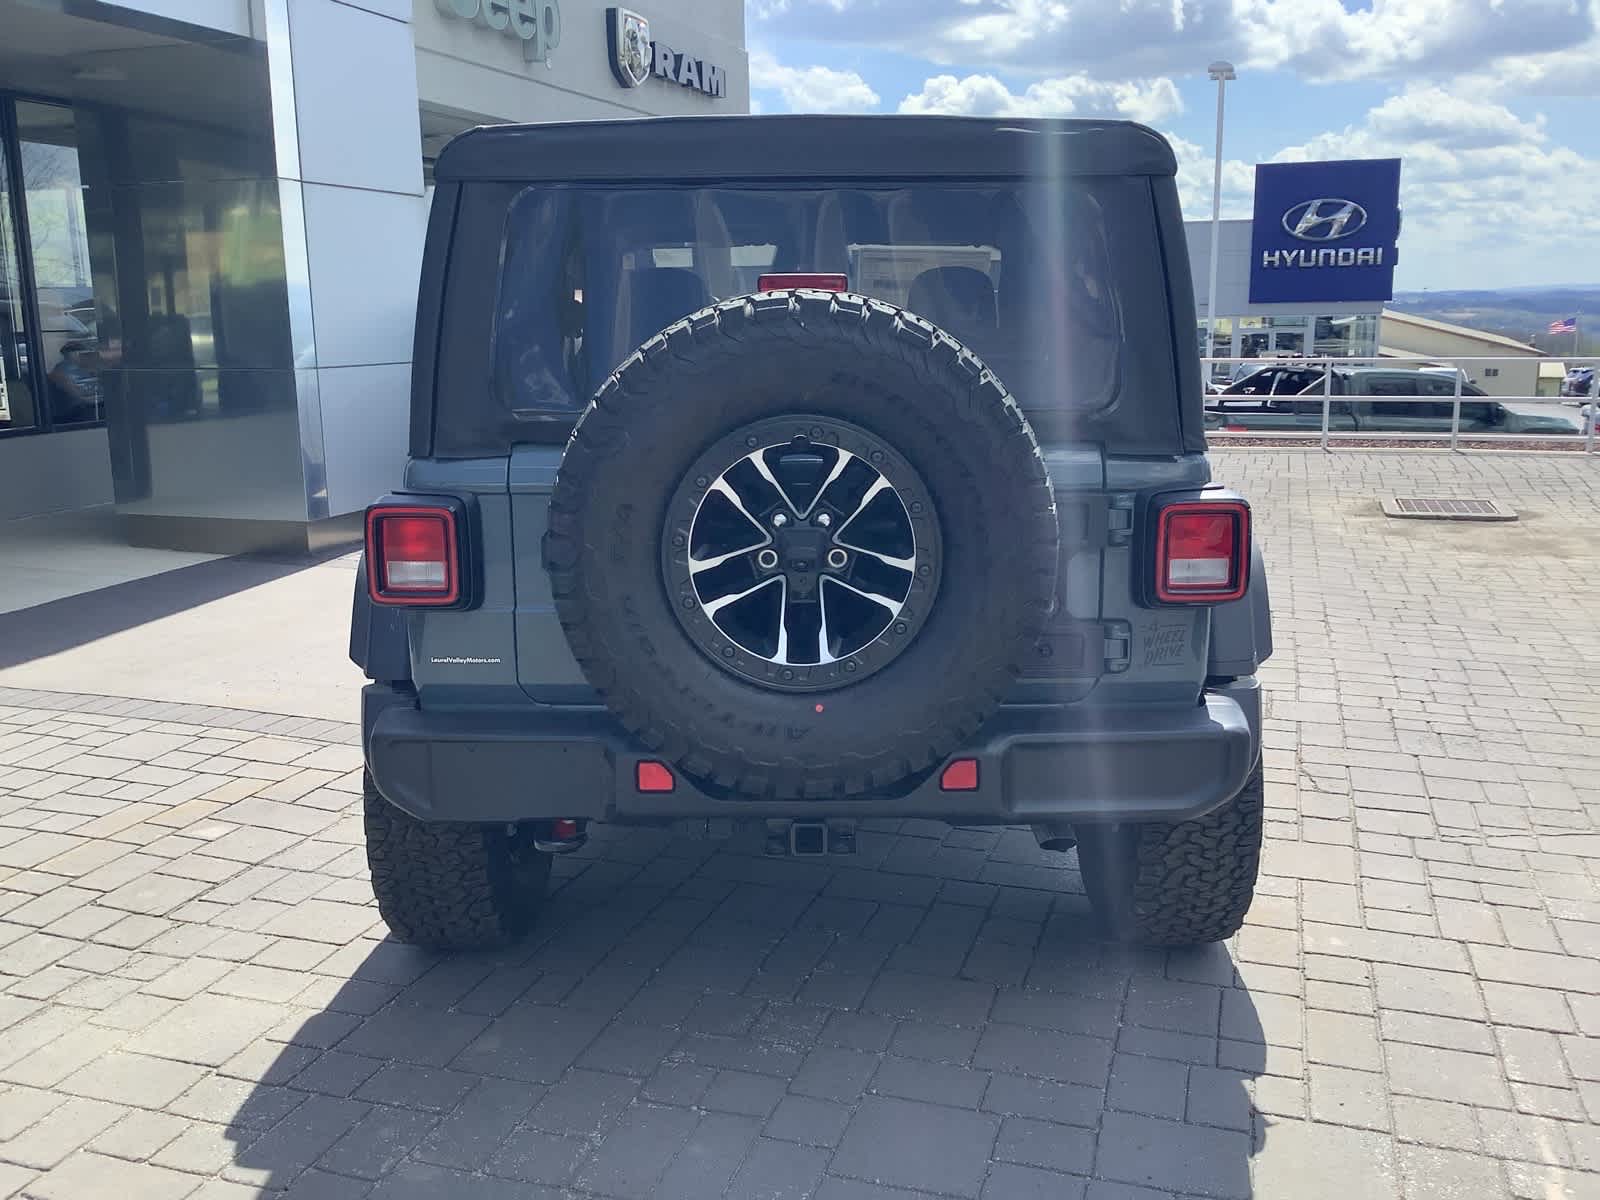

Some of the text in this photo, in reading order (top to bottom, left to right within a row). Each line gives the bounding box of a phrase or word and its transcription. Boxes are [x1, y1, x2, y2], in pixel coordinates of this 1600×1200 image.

[433, 0, 560, 62] eep
[650, 41, 726, 98] RAM
[1263, 247, 1383, 268] HYUNDAI
[430, 656, 501, 665] LaurelValleyMotors.com
